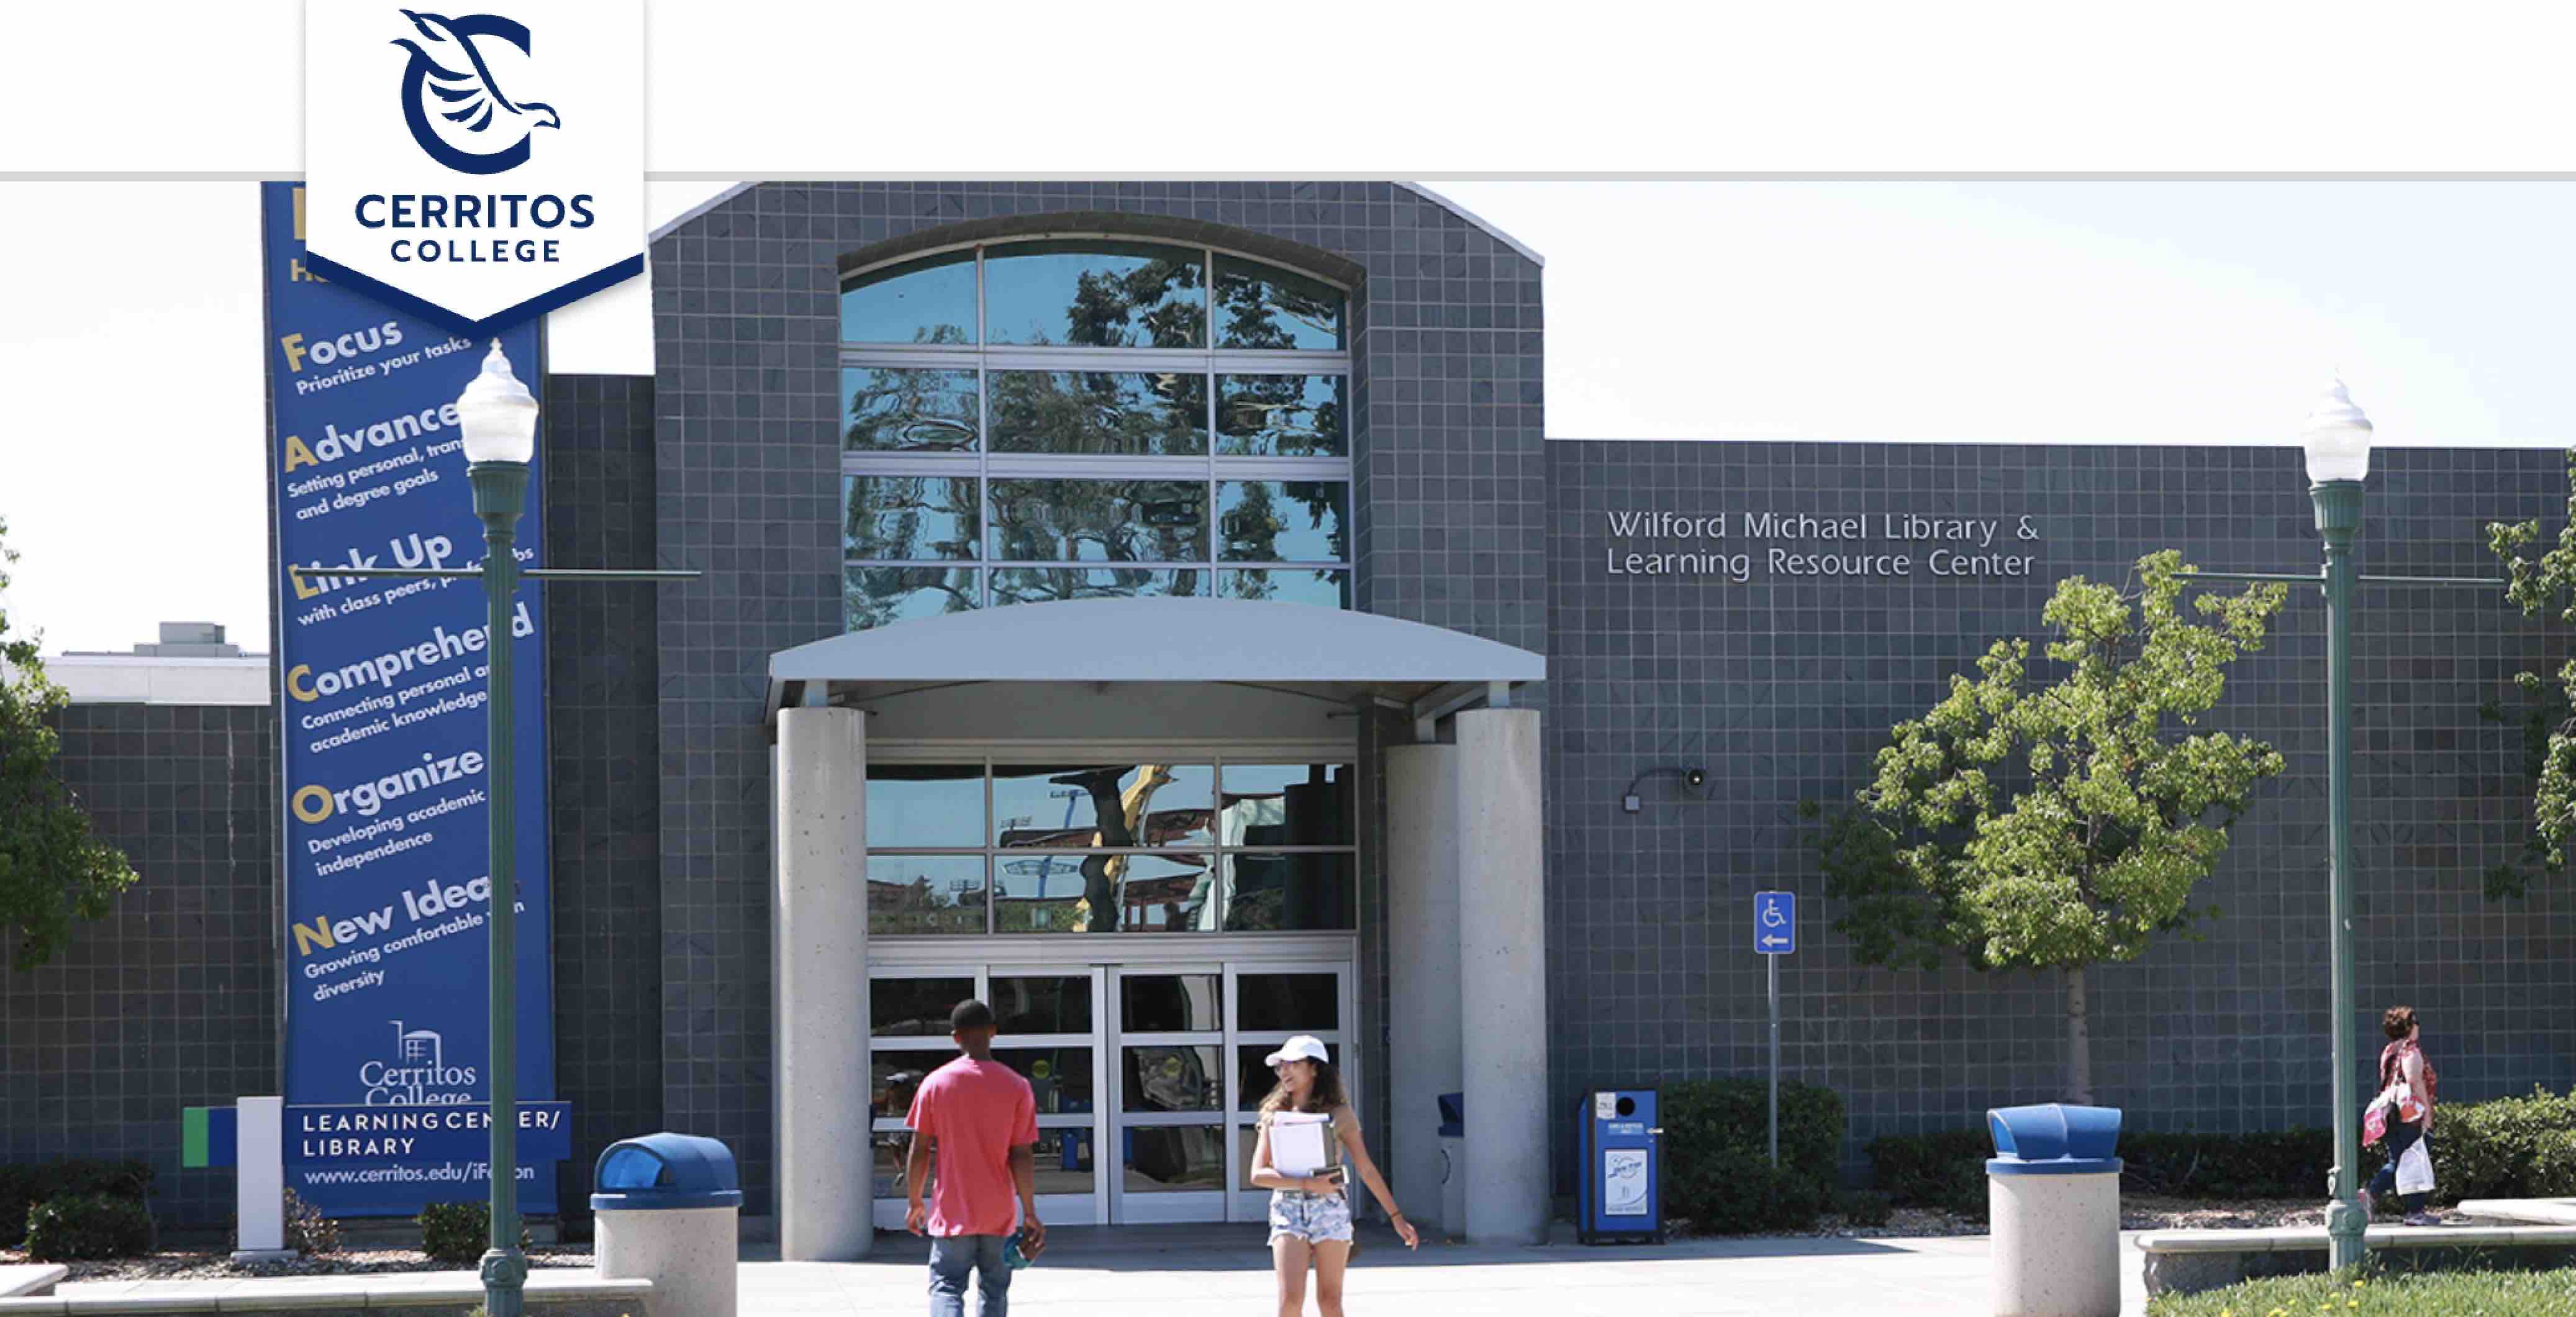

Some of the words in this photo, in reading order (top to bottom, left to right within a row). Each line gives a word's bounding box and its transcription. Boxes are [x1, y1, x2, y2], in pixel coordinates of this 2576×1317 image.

[281, 321, 402, 372] Focus
[296, 365, 376, 395] Prioritize
[379, 350, 420, 375] your
[424, 336, 472, 358] tasks
[284, 402, 461, 473] Advance
[288, 469, 345, 498] Setting
[348, 448, 425, 483] personal,
[427, 439, 463, 457] tran
[296, 498, 329, 521] and
[333, 482, 391, 509] degree
[394, 468, 439, 494] goals
[1608, 511, 1726, 539] Wilford
[1744, 513, 1866, 539] Michael
[1885, 513, 1998, 547] Library
[2016, 515, 2039, 540] &
[288, 547, 378, 600] Link
[390, 533, 453, 571] Up
[1607, 549, 1751, 583] Learning
[1769, 549, 1910, 576] Resource
[1929, 550, 2036, 576] Center
[297, 603, 337, 626] with
[340, 591, 381, 614] class
[384, 578, 436, 604] peers,
[288, 601, 534, 701] Comprehed
[302, 696, 395, 730] Connecting
[397, 667, 471, 704] personal
[311, 721, 390, 753] academic
[392, 691, 488, 728] knowledge
[292, 750, 484, 824] Organize
[307, 816, 404, 855] Developing
[407, 789, 488, 823] academic
[315, 831, 433, 876] independence
[292, 905, 394, 956] New
[402, 875, 491, 922] Idea
[304, 947, 381, 978] Growing
[383, 912, 484, 954] comfortable
[314, 969, 384, 1001] diversity
[360, 1061, 476, 1087] Cerritos
[302, 1112, 438, 1131] LEARNING
[446, 1110, 561, 1130] CENER/
[303, 1137, 415, 1157] LIBRARY
[304, 1162, 535, 1184] www.cerritos.edu/iFon
